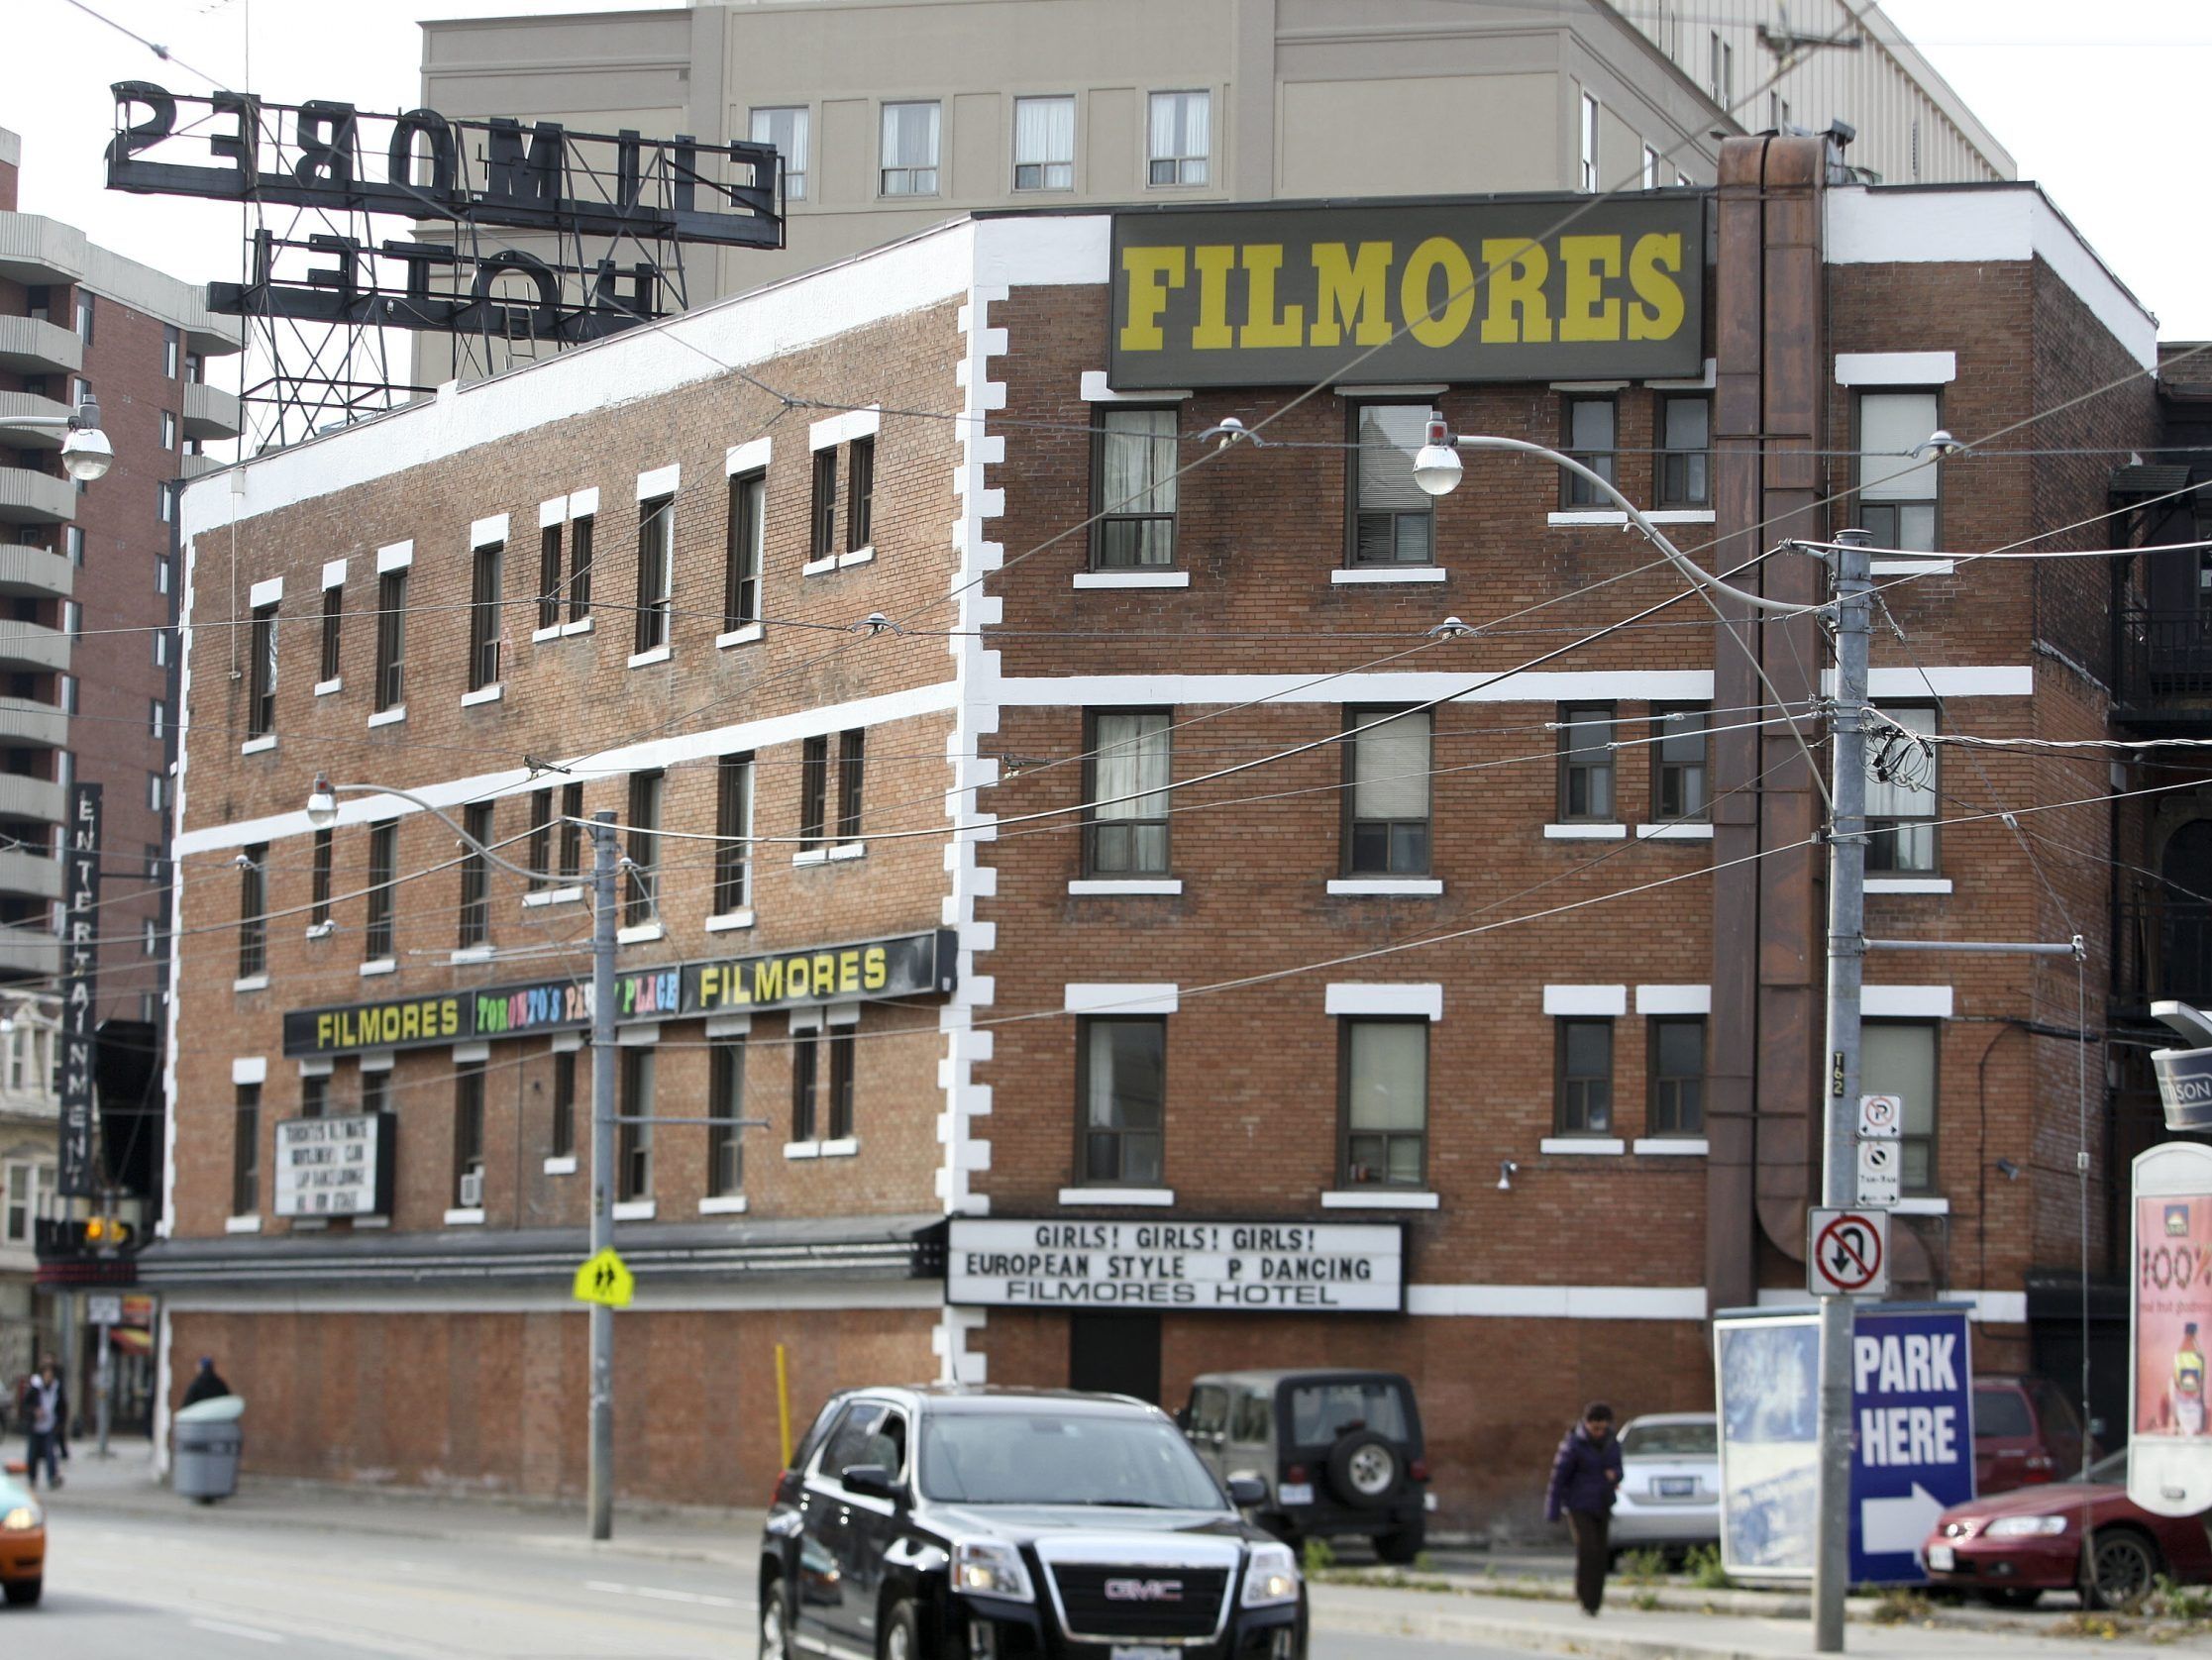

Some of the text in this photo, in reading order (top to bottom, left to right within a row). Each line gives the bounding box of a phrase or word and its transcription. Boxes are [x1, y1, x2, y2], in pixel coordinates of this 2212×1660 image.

[1119, 233, 1686, 352] FILMORES
[65, 799, 94, 1188] ENTERTAINMENT
[477, 973, 679, 1033] TORONTO'S PAR PLACE
[699, 946, 887, 1008] FILMORES
[317, 998, 459, 1050] FILMORES
[966, 1253, 1090, 1278] EUROPEAN
[1107, 1255, 1185, 1279] STYLE
[1261, 1258, 1372, 1281] DANCING
[1036, 1225, 1316, 1252] GIRLS! GIRLS! GIRLS!
[1005, 1281, 1339, 1305] FILMORES HOTEL
[1853, 1333, 1957, 1394] PARK
[1859, 1405, 1957, 1467] HERE
[1105, 1579, 1184, 1601] GMC
